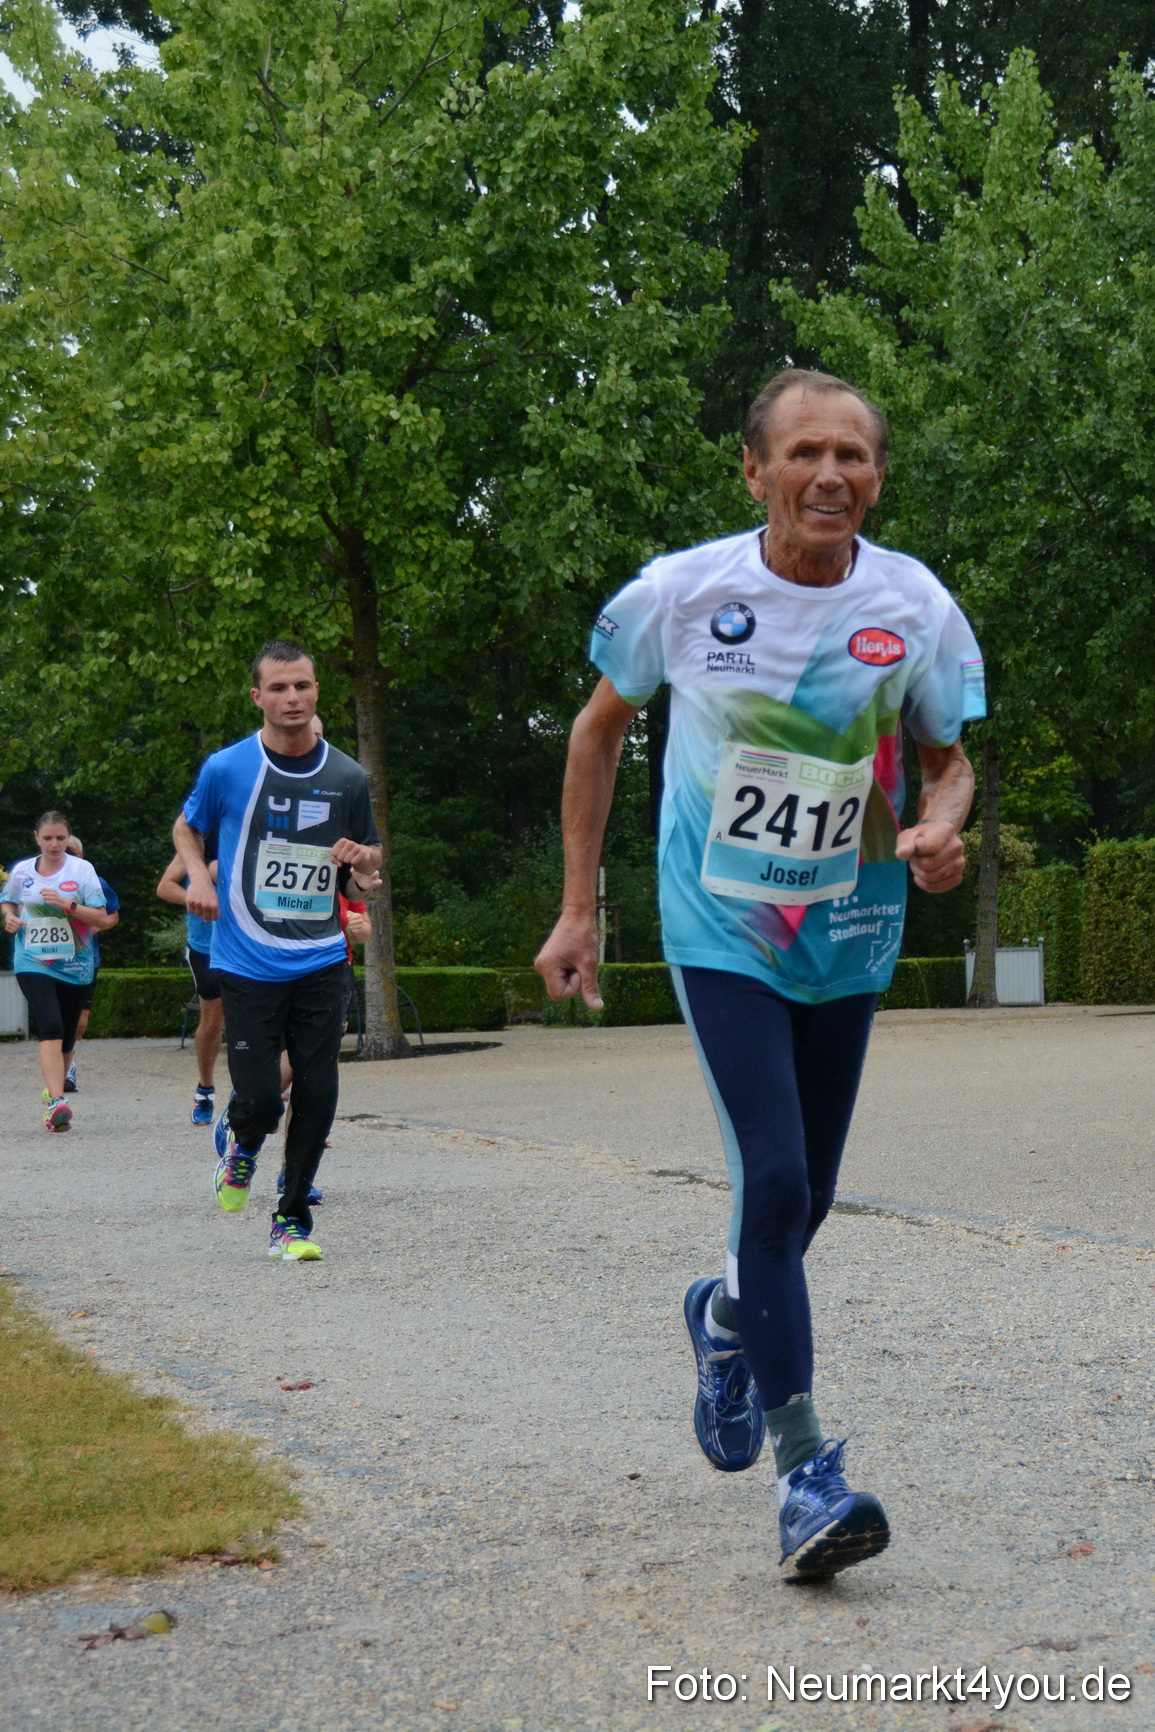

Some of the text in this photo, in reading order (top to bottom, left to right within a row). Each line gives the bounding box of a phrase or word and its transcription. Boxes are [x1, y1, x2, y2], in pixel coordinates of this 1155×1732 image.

[855, 636, 902, 656] Hervis
[707, 651, 756, 666] PARTL
[707, 664, 756, 675] Neumarkt
[734, 762, 789, 779] NeuerMarkt
[798, 761, 866, 788] BOCK
[728, 785, 860, 851] 2412
[264, 860, 332, 892] 2579
[760, 860, 819, 886] Josef
[277, 896, 313, 910] Michal
[829, 904, 902, 924] Neumarkter
[30, 927, 70, 944] 2283
[829, 920, 884, 942] Stadtlauf
[41, 947, 58, 955] Nicki
